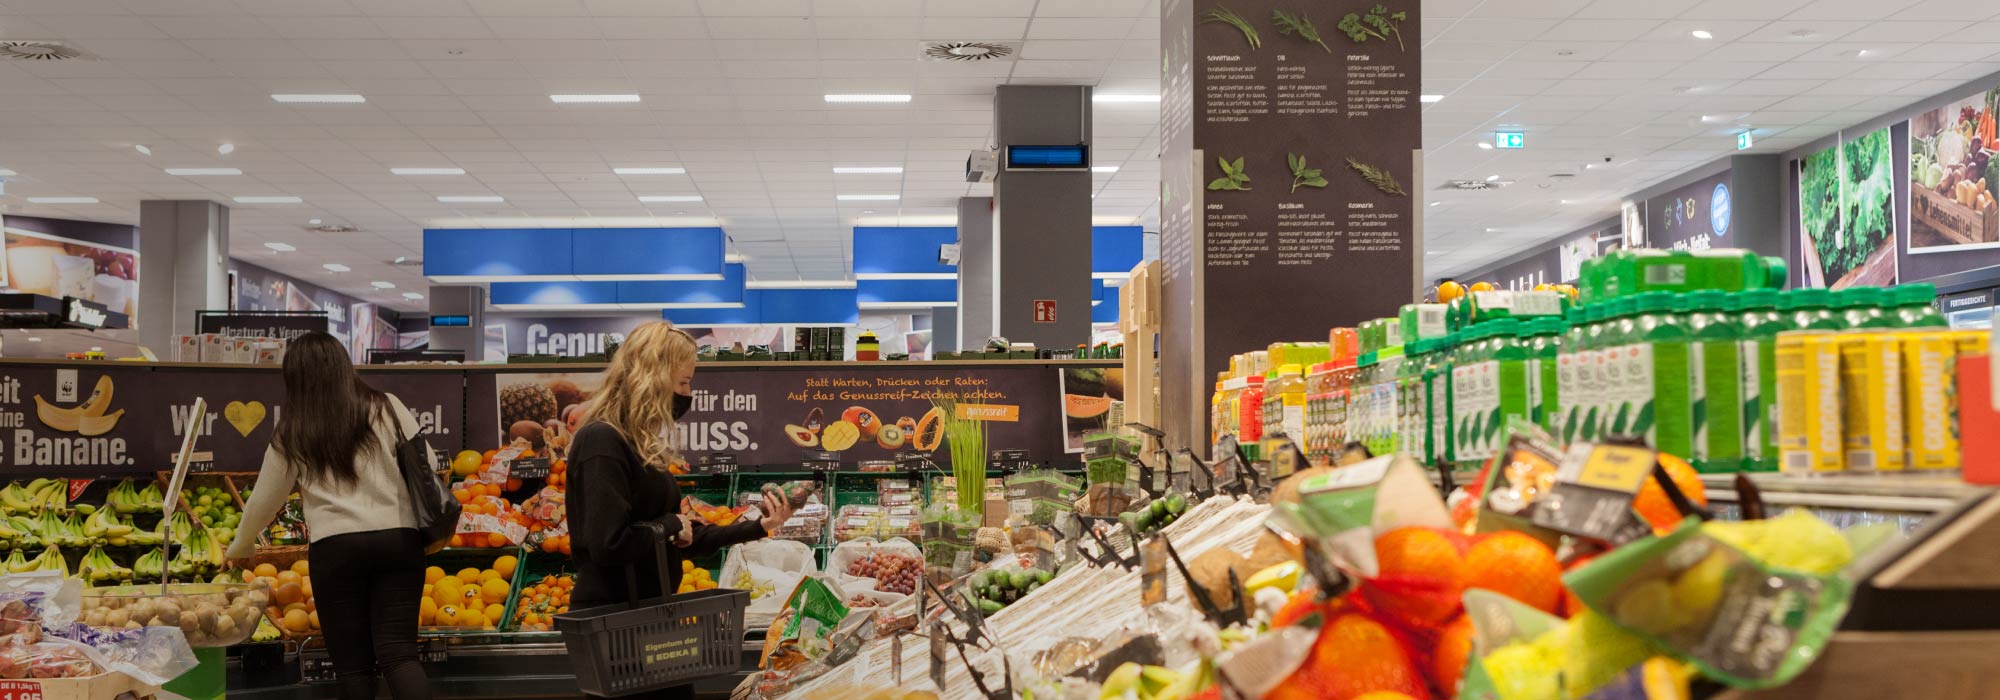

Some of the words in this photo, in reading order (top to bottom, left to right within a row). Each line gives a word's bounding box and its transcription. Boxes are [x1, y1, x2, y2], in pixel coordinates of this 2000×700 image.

[806, 377, 829, 387] Statt
[832, 377, 871, 388] Warten,
[876, 377, 921, 387] Drücken
[924, 378, 950, 387] oder
[954, 376, 988, 387] Raten:
[690, 390, 719, 412] für
[723, 389, 757, 412] den
[787, 391, 808, 403] Auf
[812, 391, 834, 401] das
[839, 389, 959, 402] Genussreif-Zeichen
[963, 389, 1007, 400] achten.
[14, 429, 135, 466] Banane.
[645, 640, 683, 651] Eigentum
[684, 637, 697, 645] der
[656, 648, 689, 661] EDEKA
